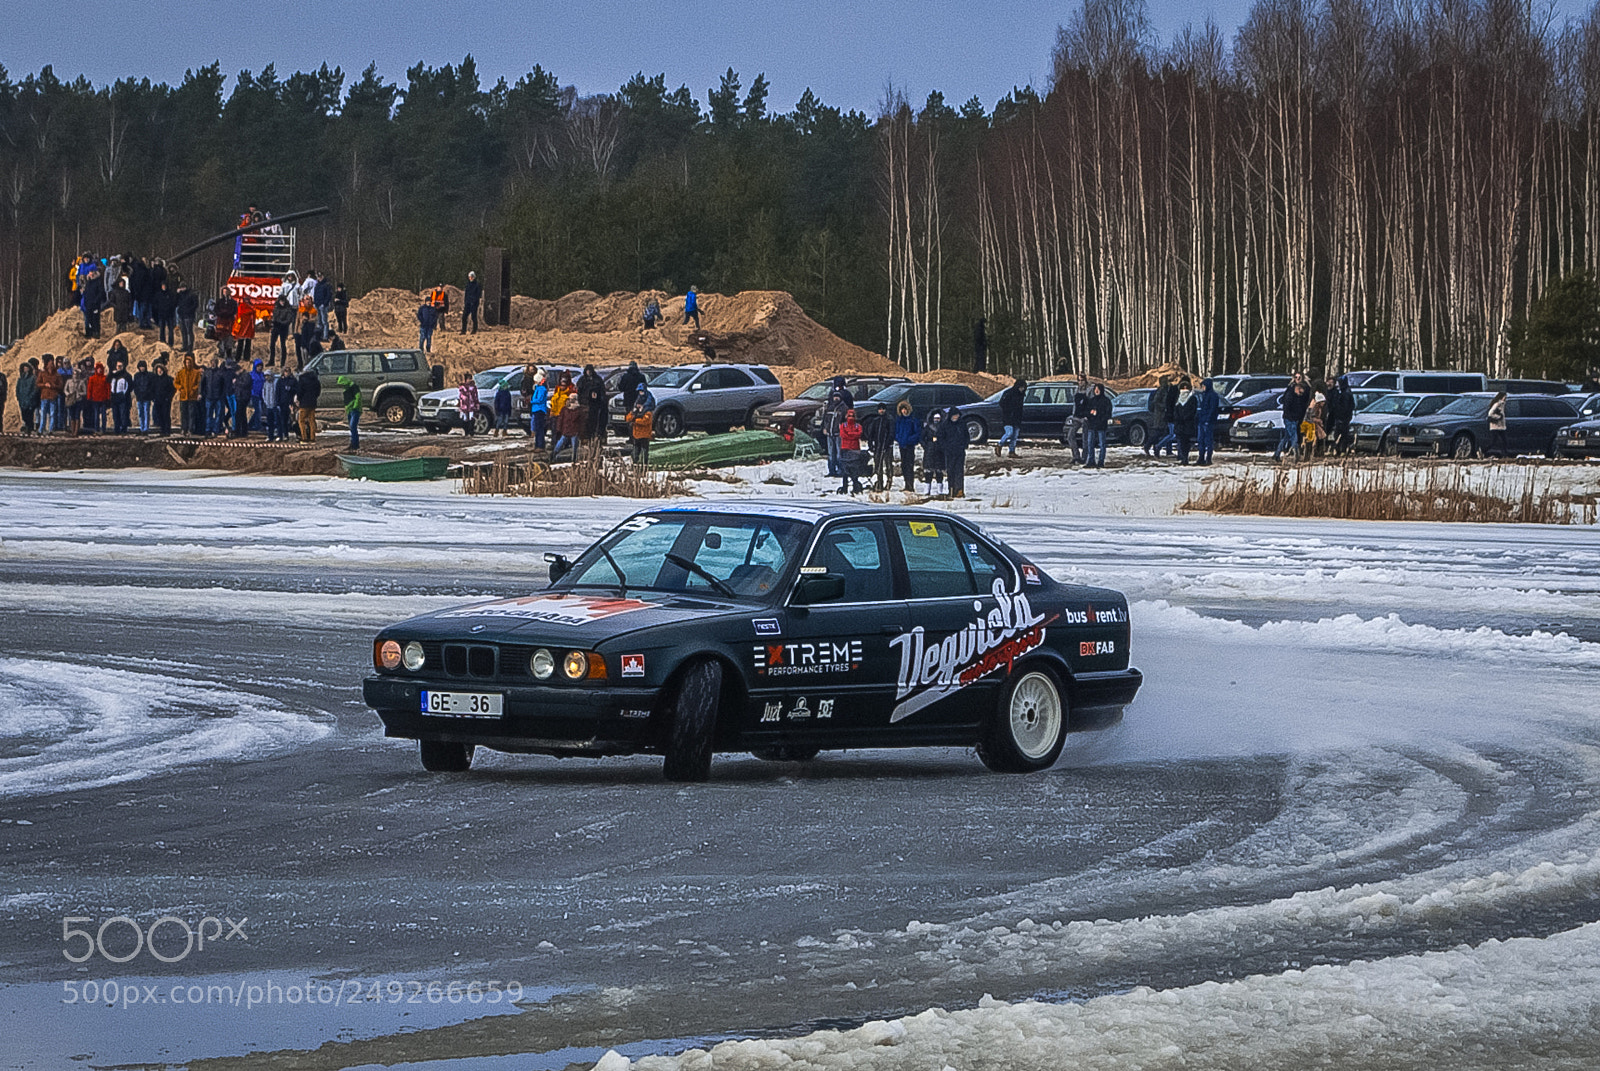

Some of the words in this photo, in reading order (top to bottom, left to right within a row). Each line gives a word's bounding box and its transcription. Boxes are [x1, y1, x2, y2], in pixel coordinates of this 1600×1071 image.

[618, 515, 660, 532] 25
[753, 640, 863, 667] EXTREME
[768, 664, 823, 676] PERFORMANCE
[825, 663, 850, 672] TYRES
[470, 695, 490, 713] 36
